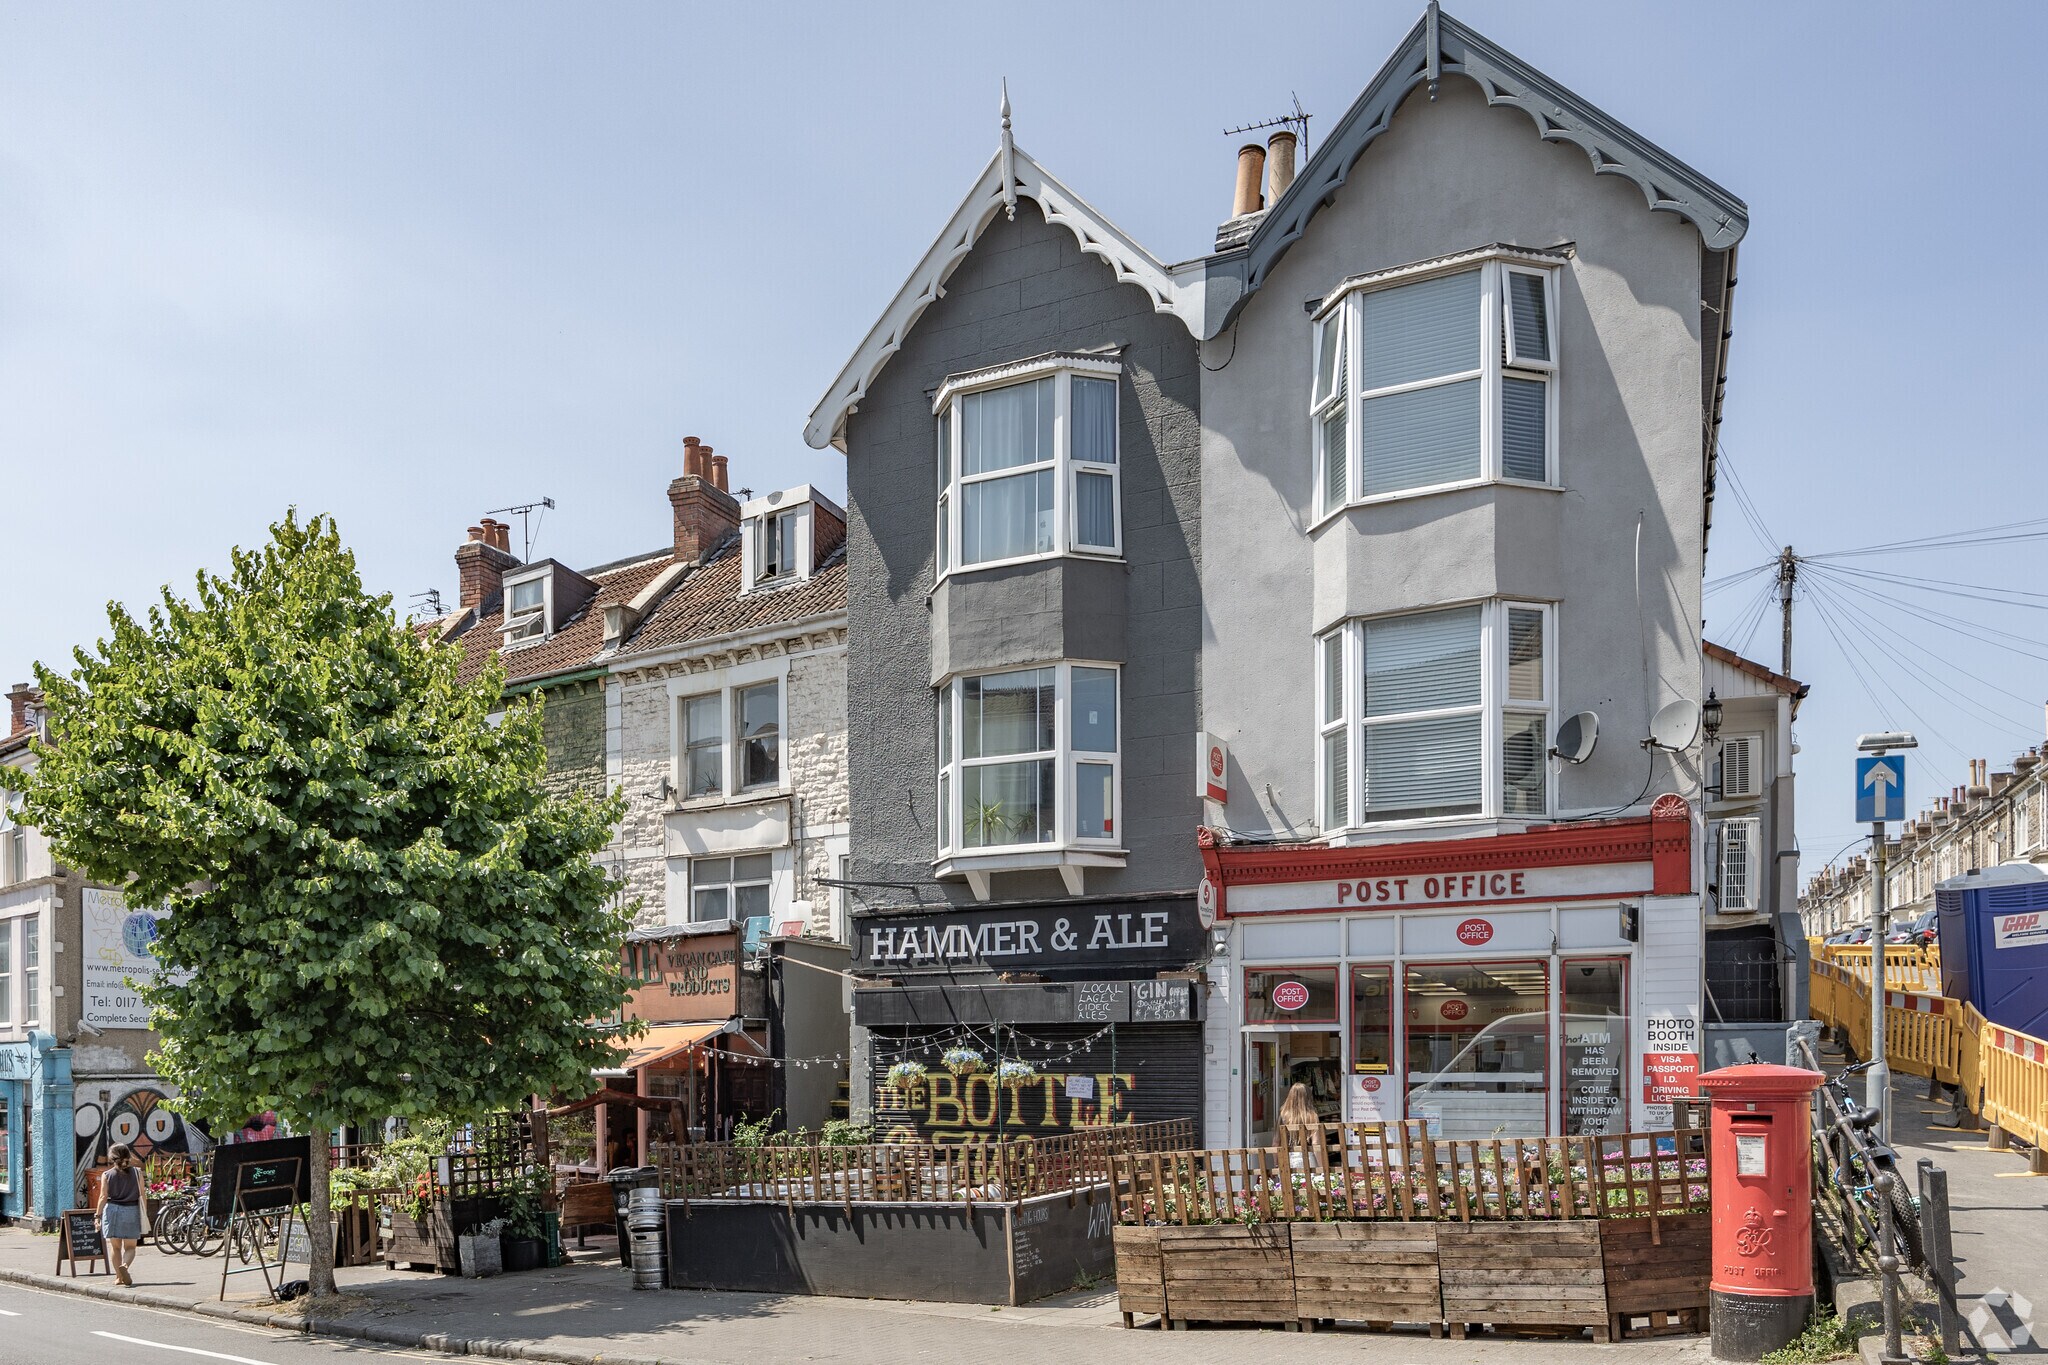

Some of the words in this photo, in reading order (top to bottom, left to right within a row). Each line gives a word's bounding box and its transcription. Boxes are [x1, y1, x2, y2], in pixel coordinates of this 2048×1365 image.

[1338, 879, 1409, 904] POST
[1424, 873, 1525, 899] OFFICE
[88, 891, 125, 907] Metro
[1465, 924, 1487, 932] POST
[870, 920, 1042, 960] HAMMER
[1050, 918, 1078, 951] &
[1086, 912, 1169, 949] ALE
[668, 951, 706, 967] VEGAN
[684, 966, 709, 980] AND
[669, 978, 730, 996] PRODUCTS
[1081, 984, 1123, 993] LOCAL
[1137, 982, 1168, 999] GIN
[90, 996, 111, 1007] Tel:
[1079, 993, 1119, 1002] LAGER
[1077, 1003, 1111, 1011] CIDER
[86, 1012, 127, 1023] Complete
[129, 1013, 150, 1023] Secur
[1078, 1011, 1108, 1020] ALES
[1647, 1019, 1694, 1029] PHOTO
[1580, 1033, 1611, 1044] ATM
[1647, 1031, 1694, 1041] BOOTH
[1653, 1043, 1688, 1051] INSIDE
[1581, 1057, 1608, 1065] BEEN
[1571, 1068, 1619, 1076] REMOVED
[1581, 1086, 1610, 1094] COME
[924, 1073, 1135, 1126] BOTTLE
[1569, 1107, 1622, 1115] WITHDRAW
[1582, 1128, 1609, 1136] CASH
[1723, 1266, 1745, 1276] POST
